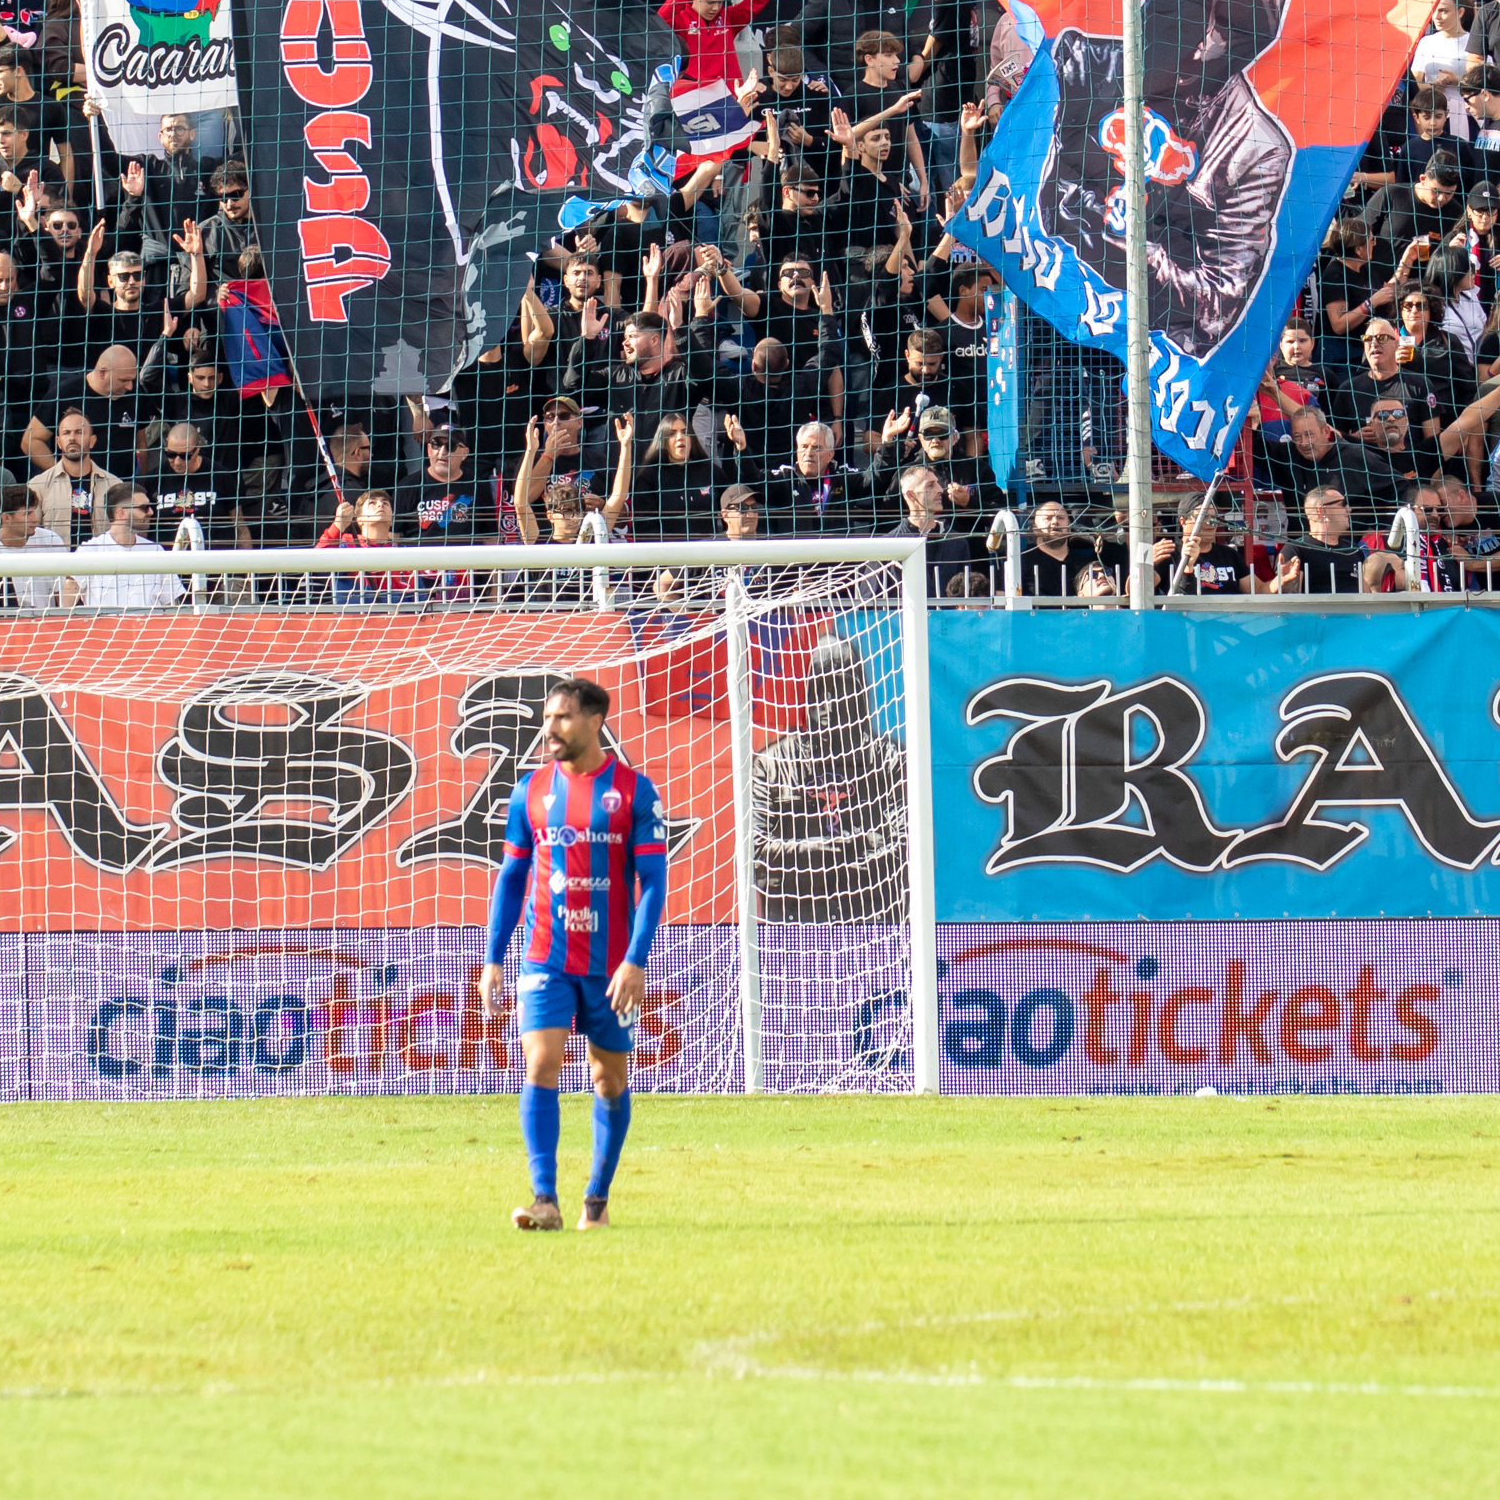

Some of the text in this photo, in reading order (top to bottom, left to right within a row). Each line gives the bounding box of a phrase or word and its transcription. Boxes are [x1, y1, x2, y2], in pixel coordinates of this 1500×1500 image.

[955, 344, 987, 358] adid
[550, 474, 572, 485] USP
[417, 499, 450, 512] CUSP
[940, 952, 1441, 1068] aotickets
[90, 962, 683, 1081] ciaoticks
